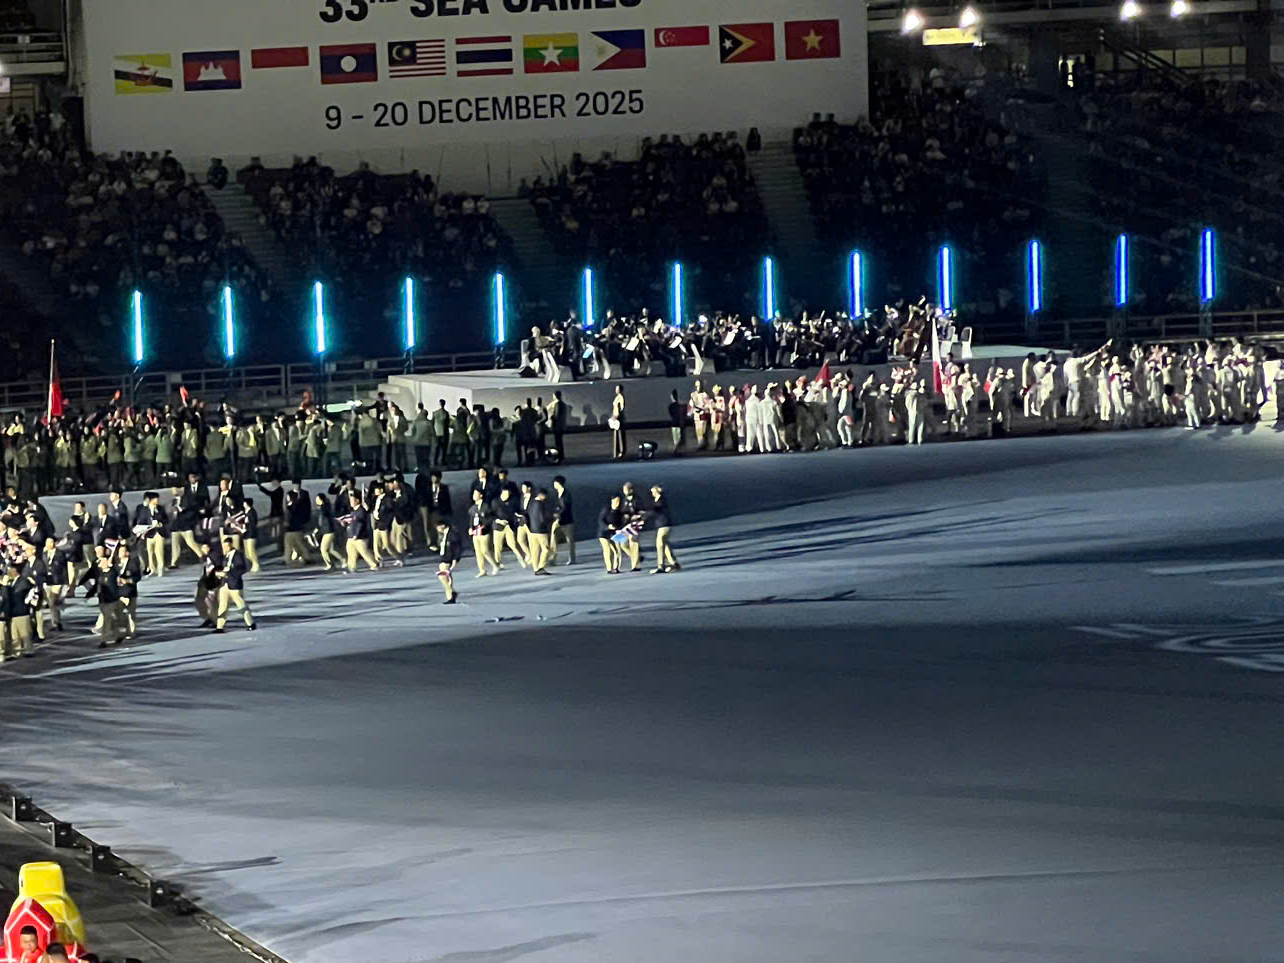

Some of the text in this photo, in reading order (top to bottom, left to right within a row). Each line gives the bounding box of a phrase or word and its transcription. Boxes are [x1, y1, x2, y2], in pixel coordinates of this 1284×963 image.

[319, 0, 398, 23] 33
[325, 105, 342, 130] 9
[373, 101, 409, 128] 20
[418, 94, 567, 125] DECEMBER
[575, 89, 644, 117] 2025
